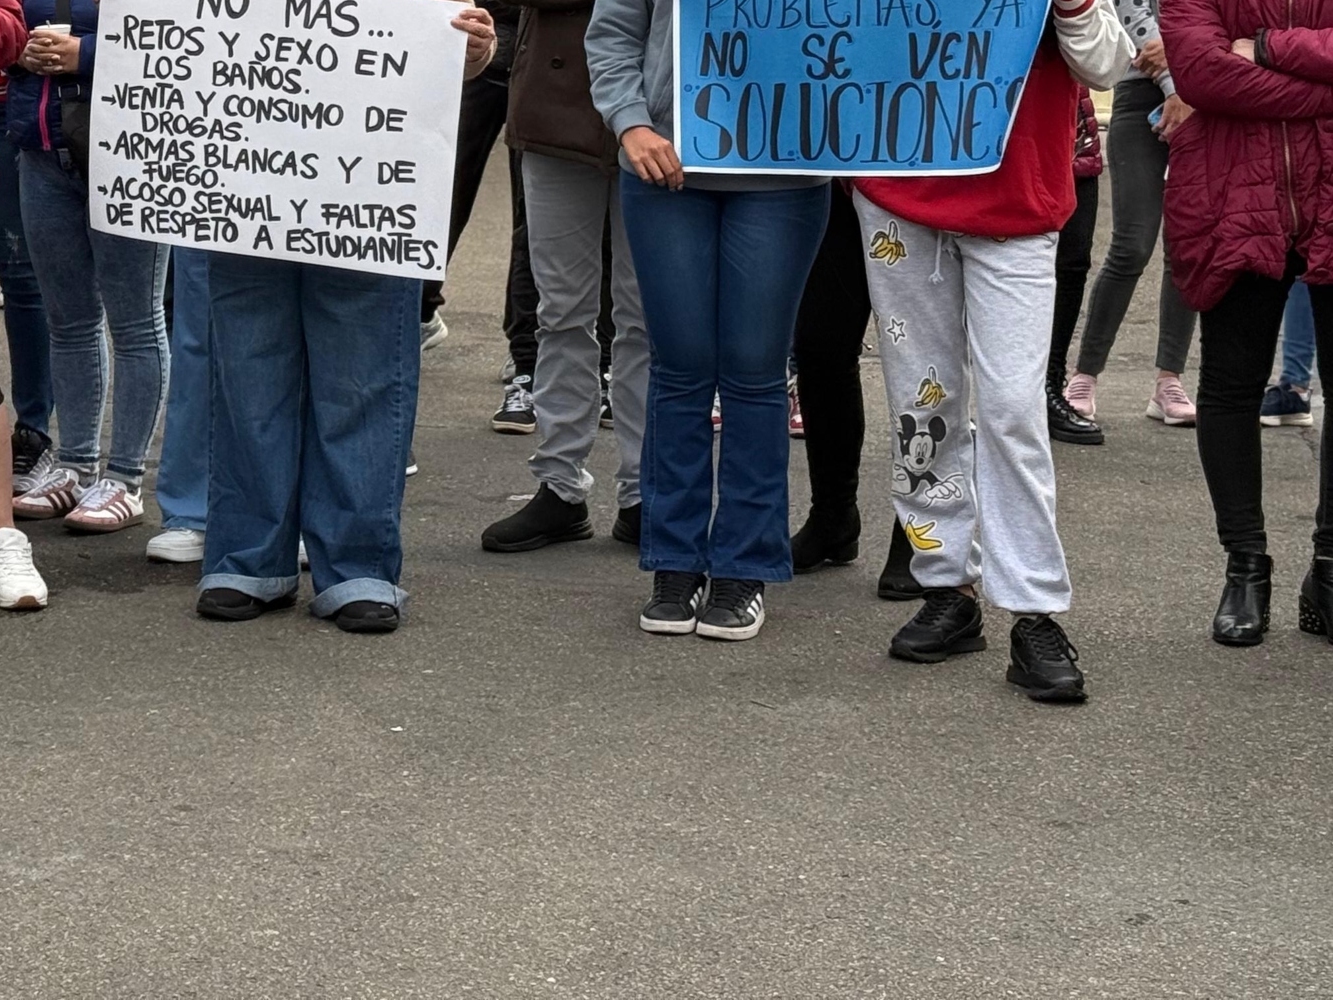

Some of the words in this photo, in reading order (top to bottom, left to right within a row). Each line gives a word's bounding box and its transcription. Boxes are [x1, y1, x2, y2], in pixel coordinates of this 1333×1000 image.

[123, 14, 205, 56] RETOS
[218, 31, 241, 58] Y
[255, 32, 338, 72] SEXO
[354, 49, 408, 78] EN
[699, 30, 748, 78] NO
[802, 30, 853, 80] SE
[908, 30, 991, 80] VEN
[143, 52, 192, 81] LOS
[212, 60, 311, 95] BAÑOS.
[114, 82, 185, 110] VENTA
[195, 90, 217, 117] Y
[223, 94, 344, 130] CONSUMO
[366, 106, 408, 132] DE
[141, 111, 250, 142] DROGAS.
[113, 130, 196, 164] ARMAS
[203, 143, 319, 180] BLANCAS
[338, 156, 363, 184] Y
[377, 160, 416, 185] DE
[143, 161, 226, 189] FUEGO.
[110, 175, 186, 208] ACOSO
[191, 190, 281, 222] SEXUAL
[290, 199, 308, 224] Y
[321, 203, 417, 232] FALTAS
[106, 203, 134, 226] DE
[141, 206, 239, 243] RESPETO
[253, 225, 274, 251] A
[286, 228, 443, 271] ESTUDIANTES.
